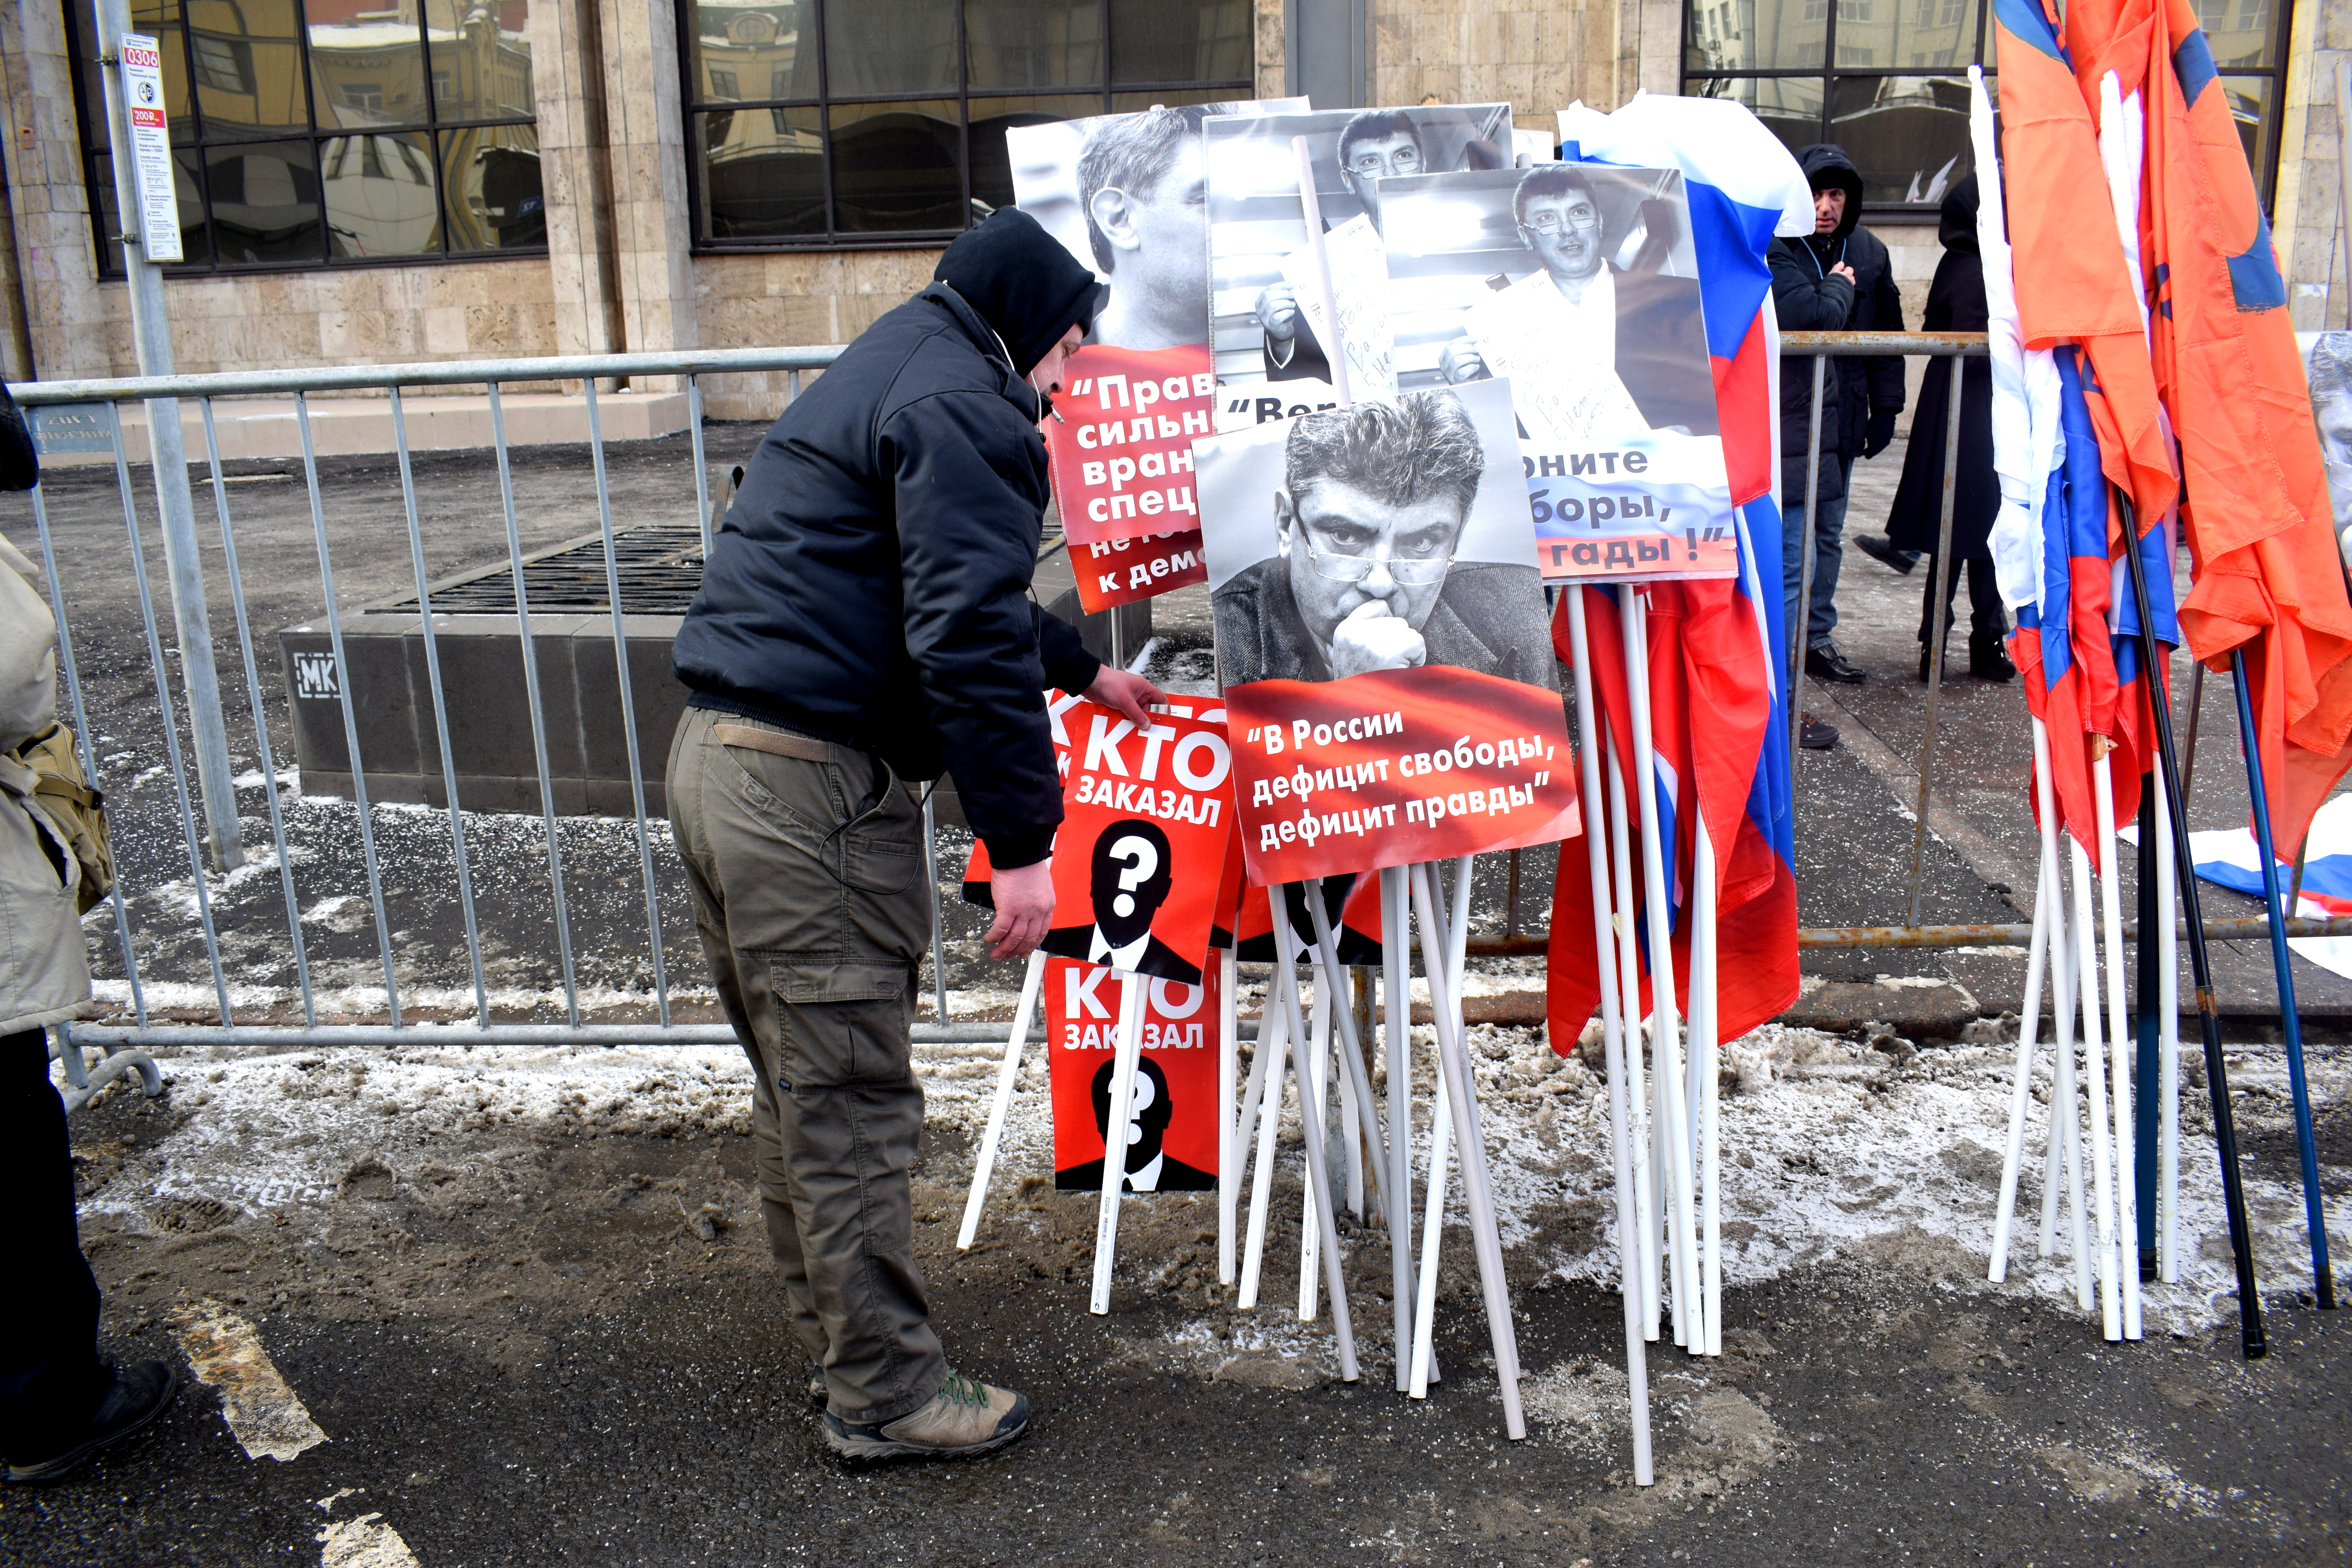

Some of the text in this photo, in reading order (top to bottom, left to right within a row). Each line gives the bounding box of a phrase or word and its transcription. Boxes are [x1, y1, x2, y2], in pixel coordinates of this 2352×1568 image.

[128, 49, 158, 67] 0306
[1077, 410, 1209, 449] сильн
[1082, 449, 1196, 491] вран
[1088, 487, 1197, 522] спец
[1090, 537, 1130, 559] не
[1551, 538, 1670, 569] гады
[1098, 572, 1120, 593] к
[1292, 711, 1403, 750] России
[1083, 714, 1231, 791] КТО
[1253, 735, 1554, 808] дефицит свободы,
[1074, 775, 1221, 827] ЗАКАЗАЛ
[1260, 802, 1396, 852] дефицит
[1109, 836, 1158, 917] ?
[1065, 967, 1204, 1019] КО
[1063, 1023, 1203, 1050] ЗАКЗАЛ
